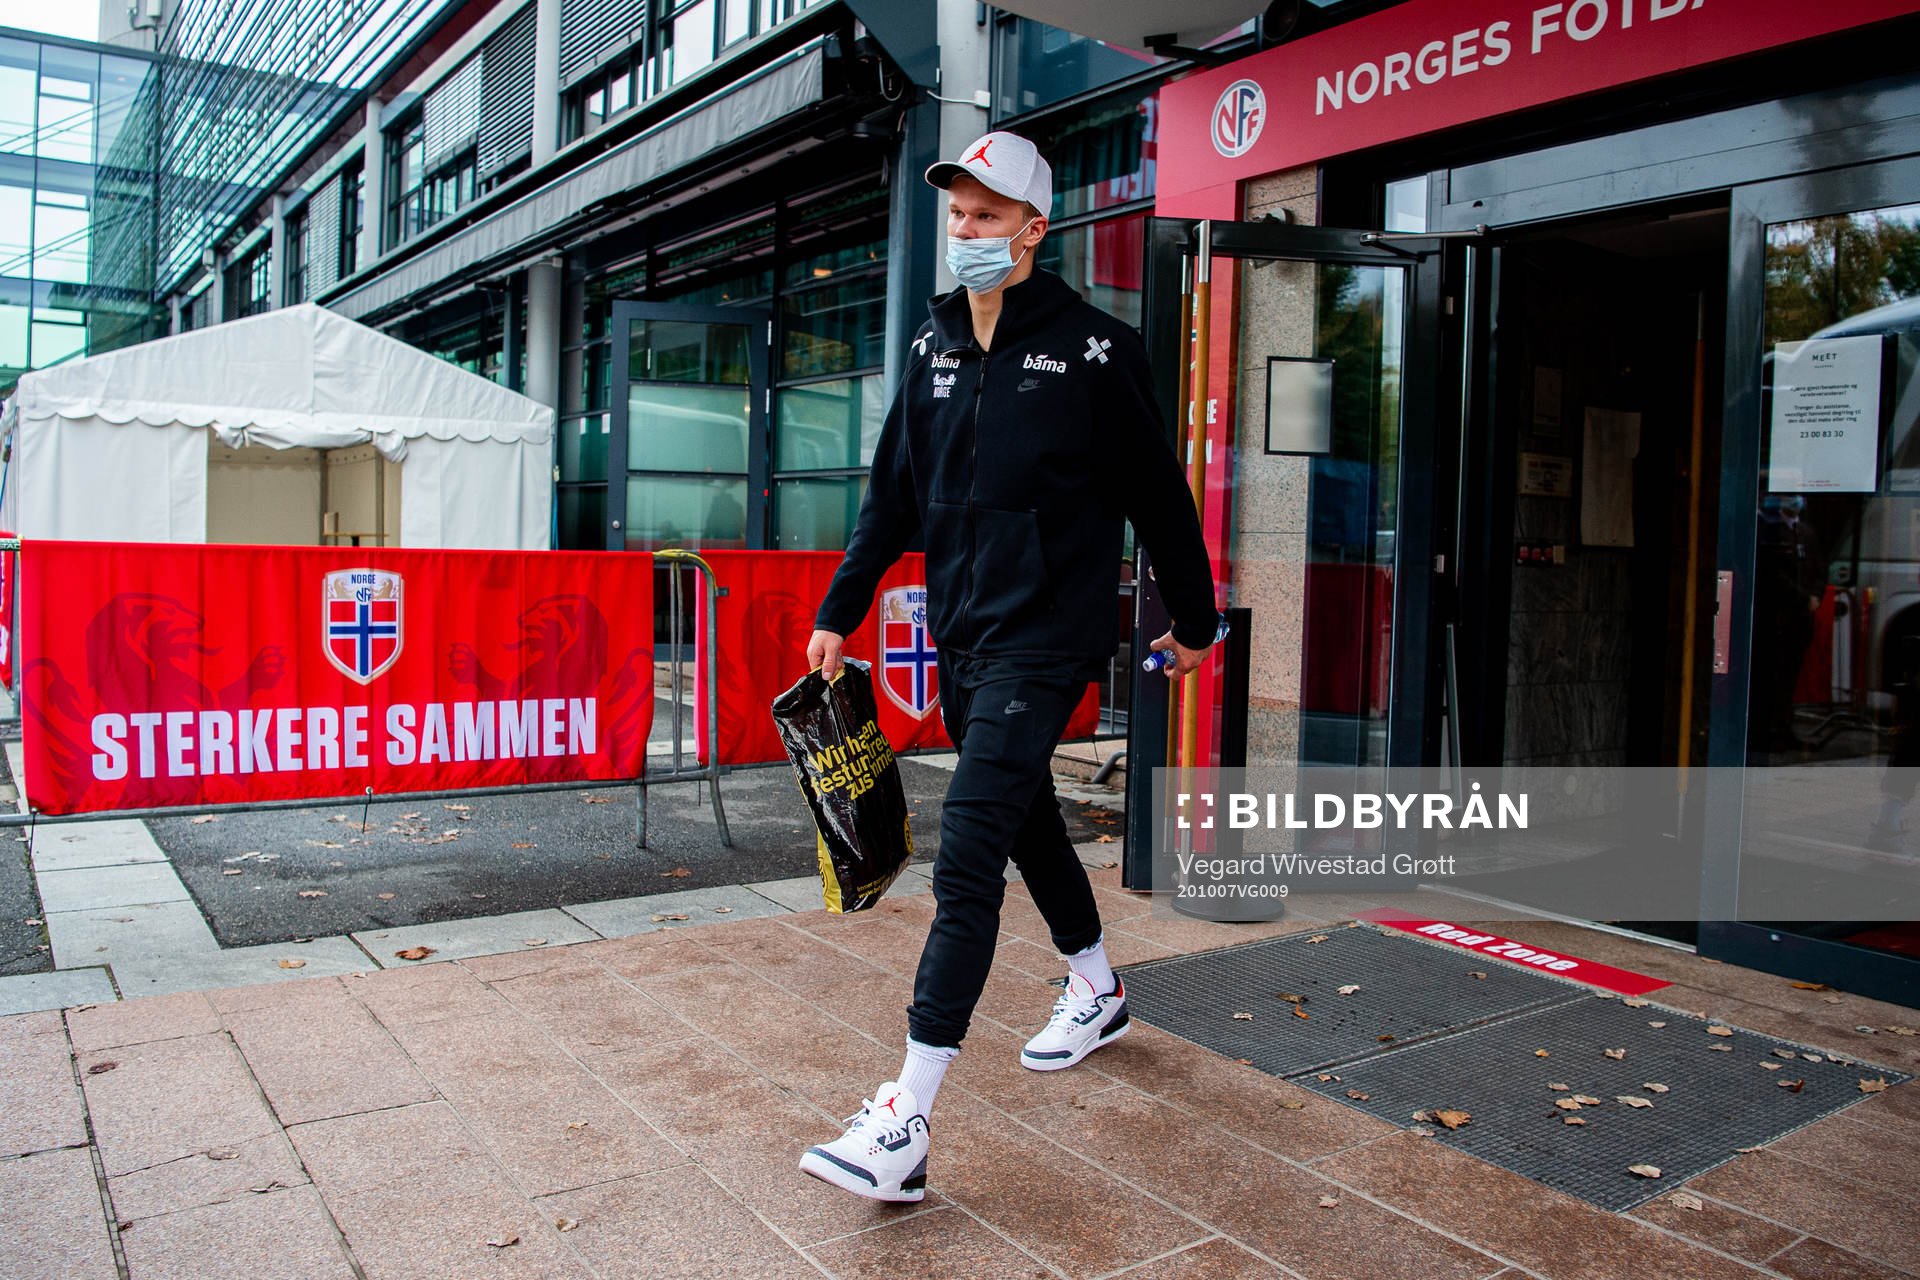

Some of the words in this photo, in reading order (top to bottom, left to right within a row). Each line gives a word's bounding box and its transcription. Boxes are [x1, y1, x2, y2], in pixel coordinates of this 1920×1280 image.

[1315, 20, 1512, 116] NORGES
[1531, 0, 1706, 55] FOTB
[1812, 352, 1838, 362] MEET
[351, 574, 376, 585] NORGE
[907, 591, 927, 604] NORG
[91, 704, 369, 781] STERKERE
[386, 696, 598, 766] SAMMEN
[807, 744, 848, 774] Wir
[1416, 923, 1496, 946] Red
[1483, 941, 1579, 971] Zone
